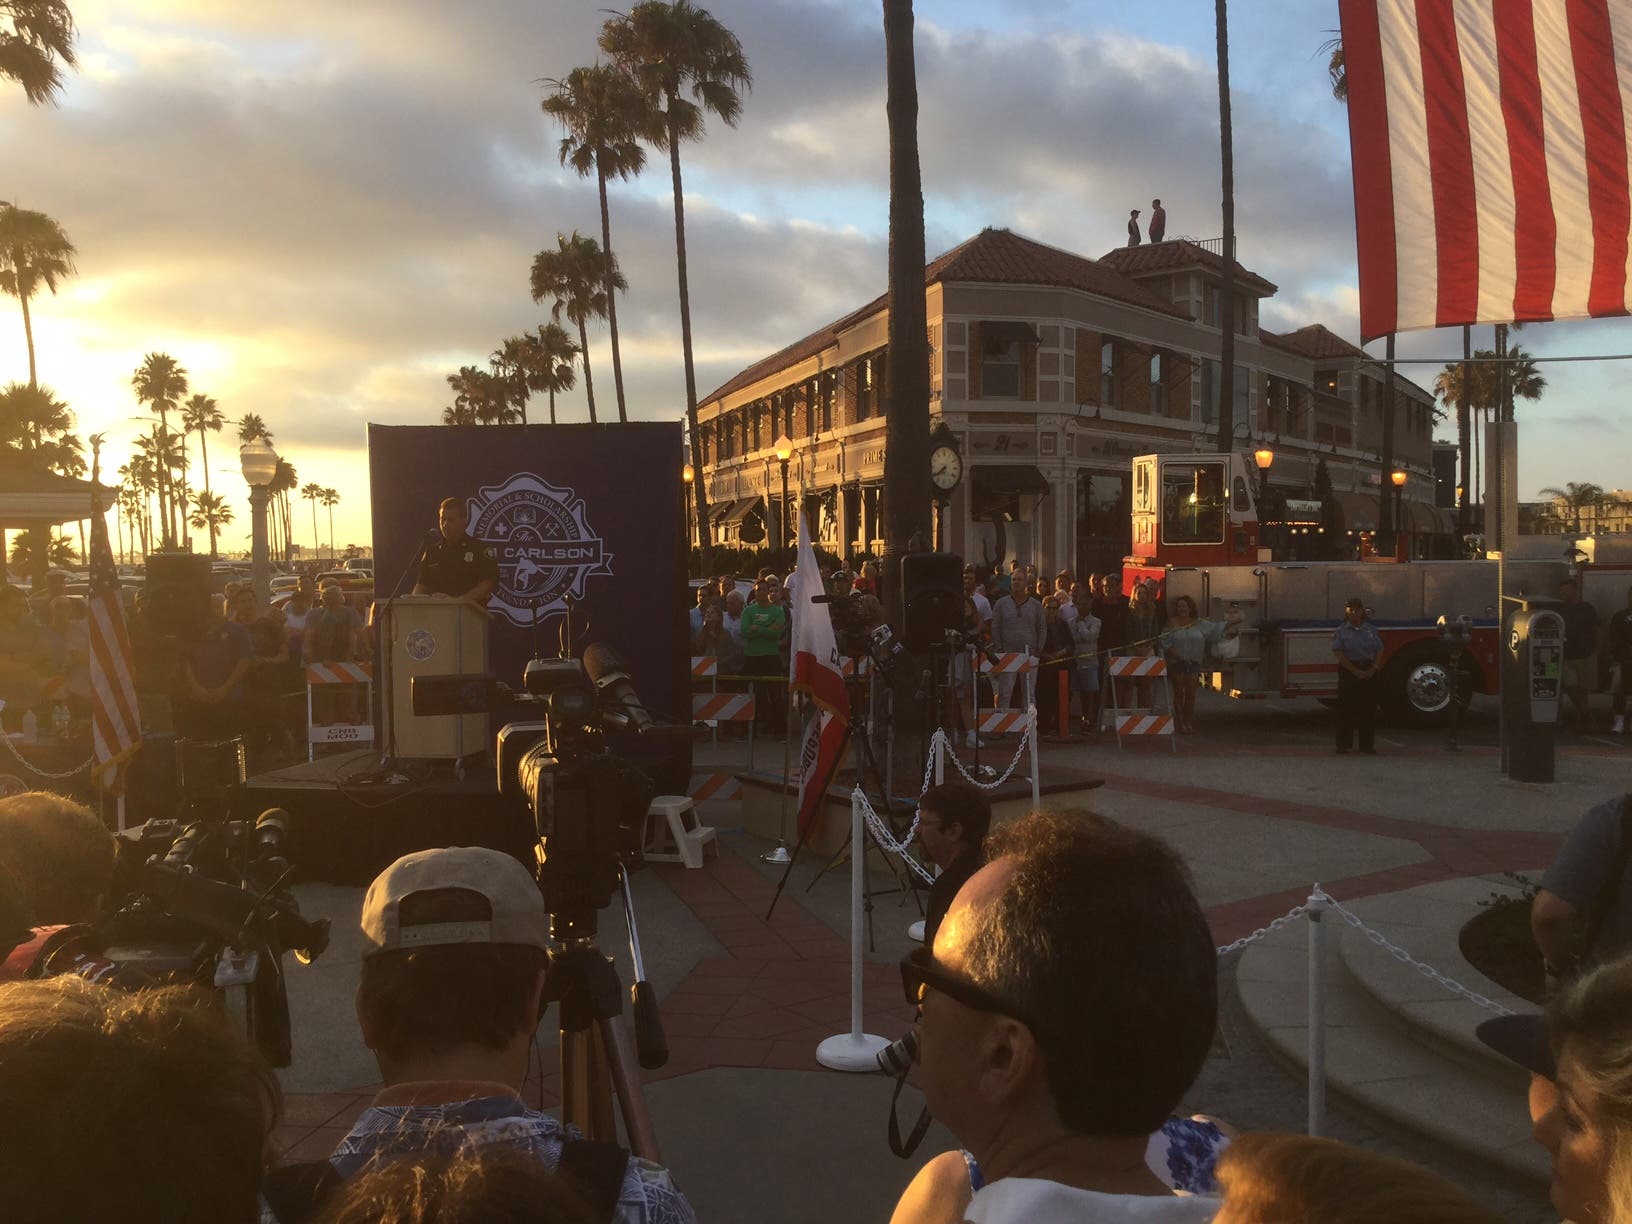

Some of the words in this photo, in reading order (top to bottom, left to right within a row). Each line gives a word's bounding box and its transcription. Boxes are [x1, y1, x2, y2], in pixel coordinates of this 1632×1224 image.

[476, 494, 514, 536] MEMORIAL
[514, 492, 523, 501] &
[524, 492, 578, 539] SCHOLARSHIP
[515, 530, 534, 542] The
[504, 547, 593, 560] CARLSON
